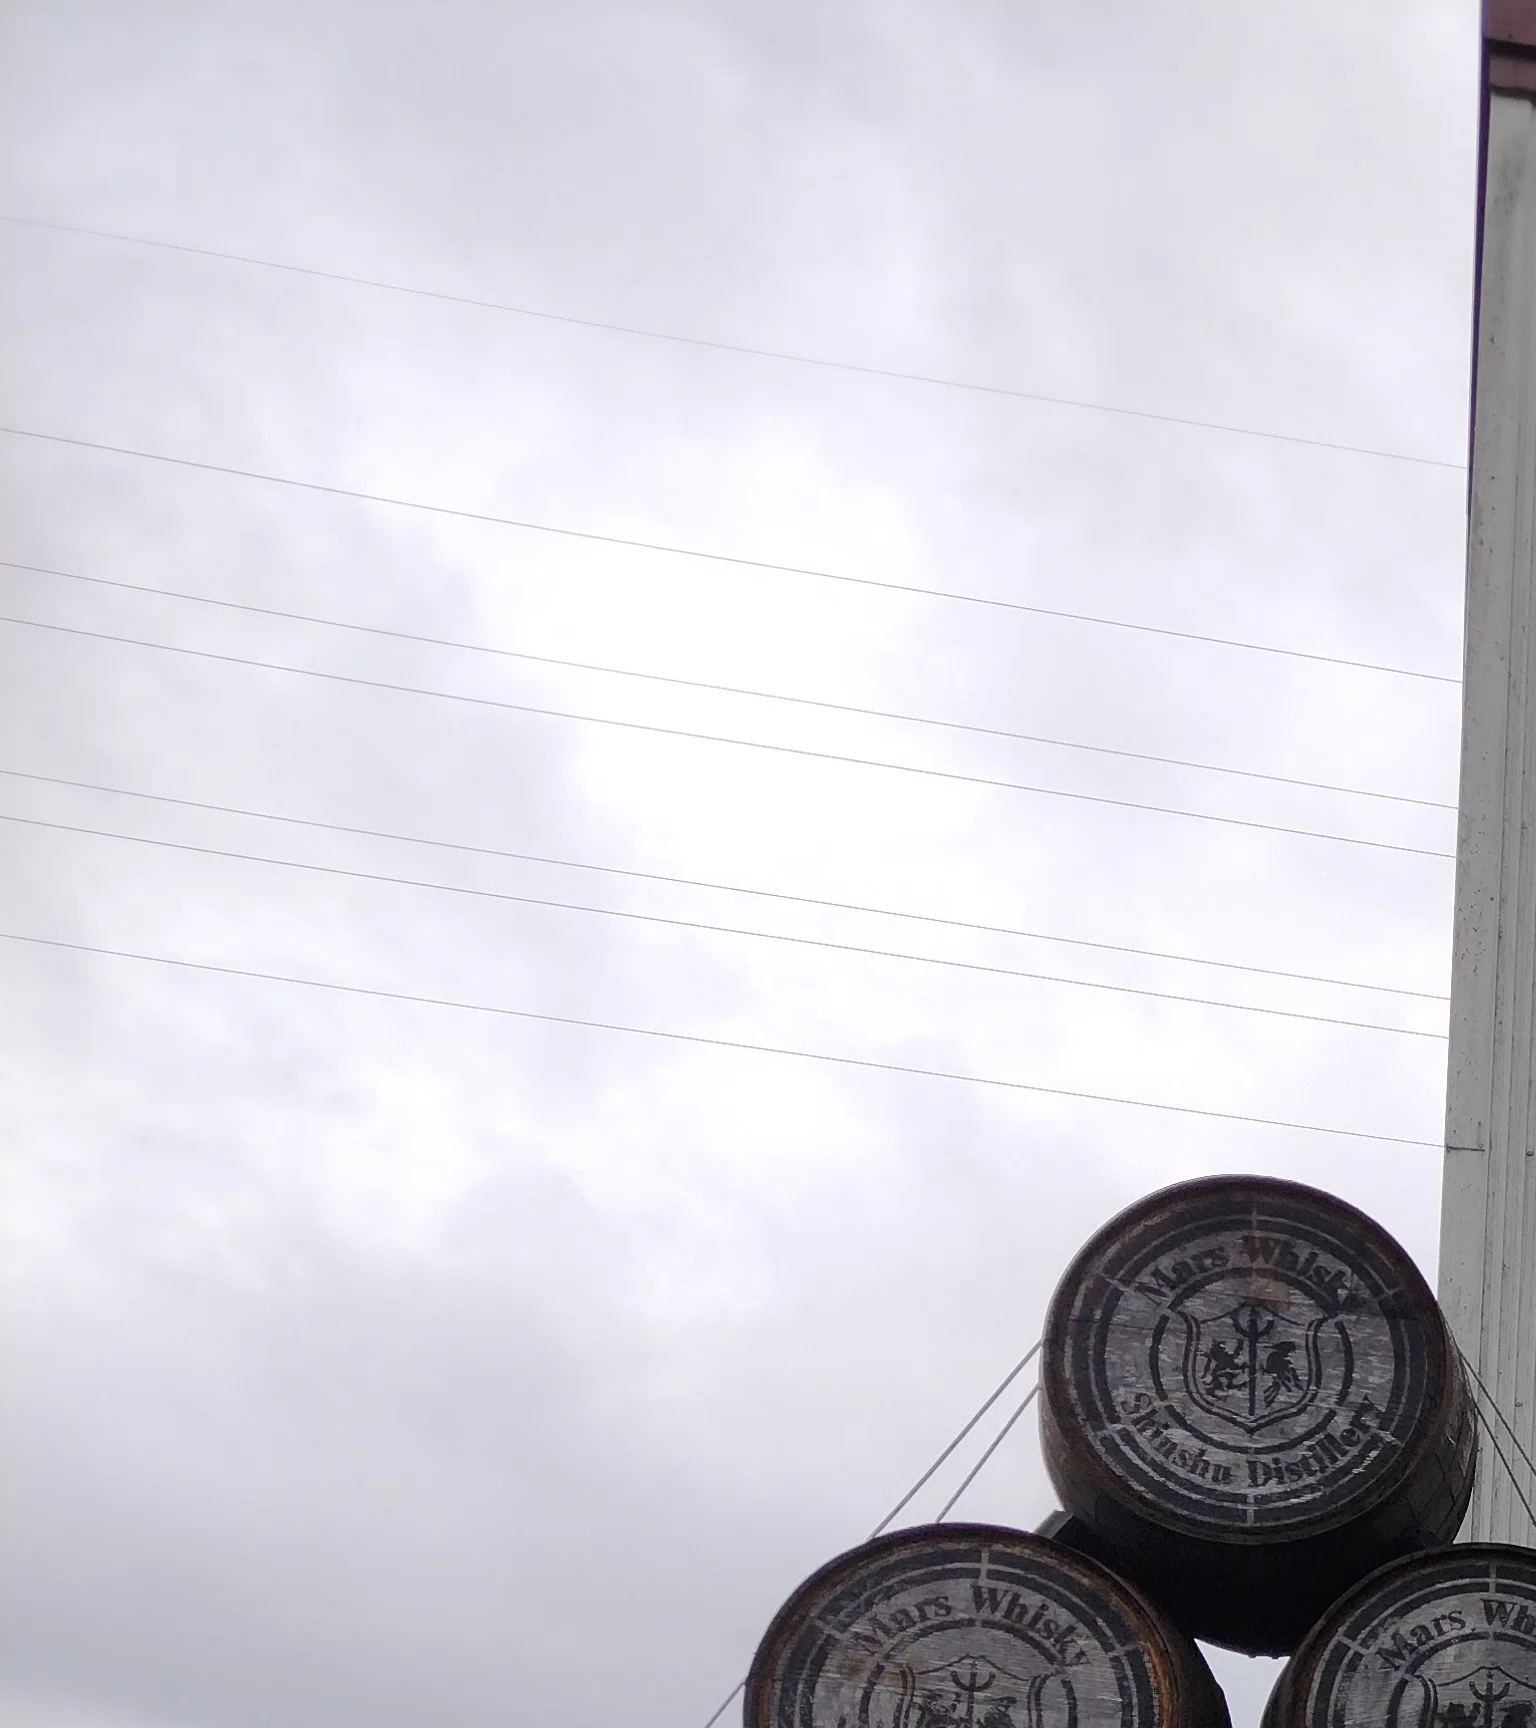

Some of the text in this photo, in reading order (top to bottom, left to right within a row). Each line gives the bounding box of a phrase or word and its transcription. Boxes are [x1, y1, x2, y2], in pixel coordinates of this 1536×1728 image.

[1137, 1247, 1230, 1305] Mars
[854, 1584, 1094, 1669] Mars Whisky
[1376, 1607, 1465, 1672] Mars
